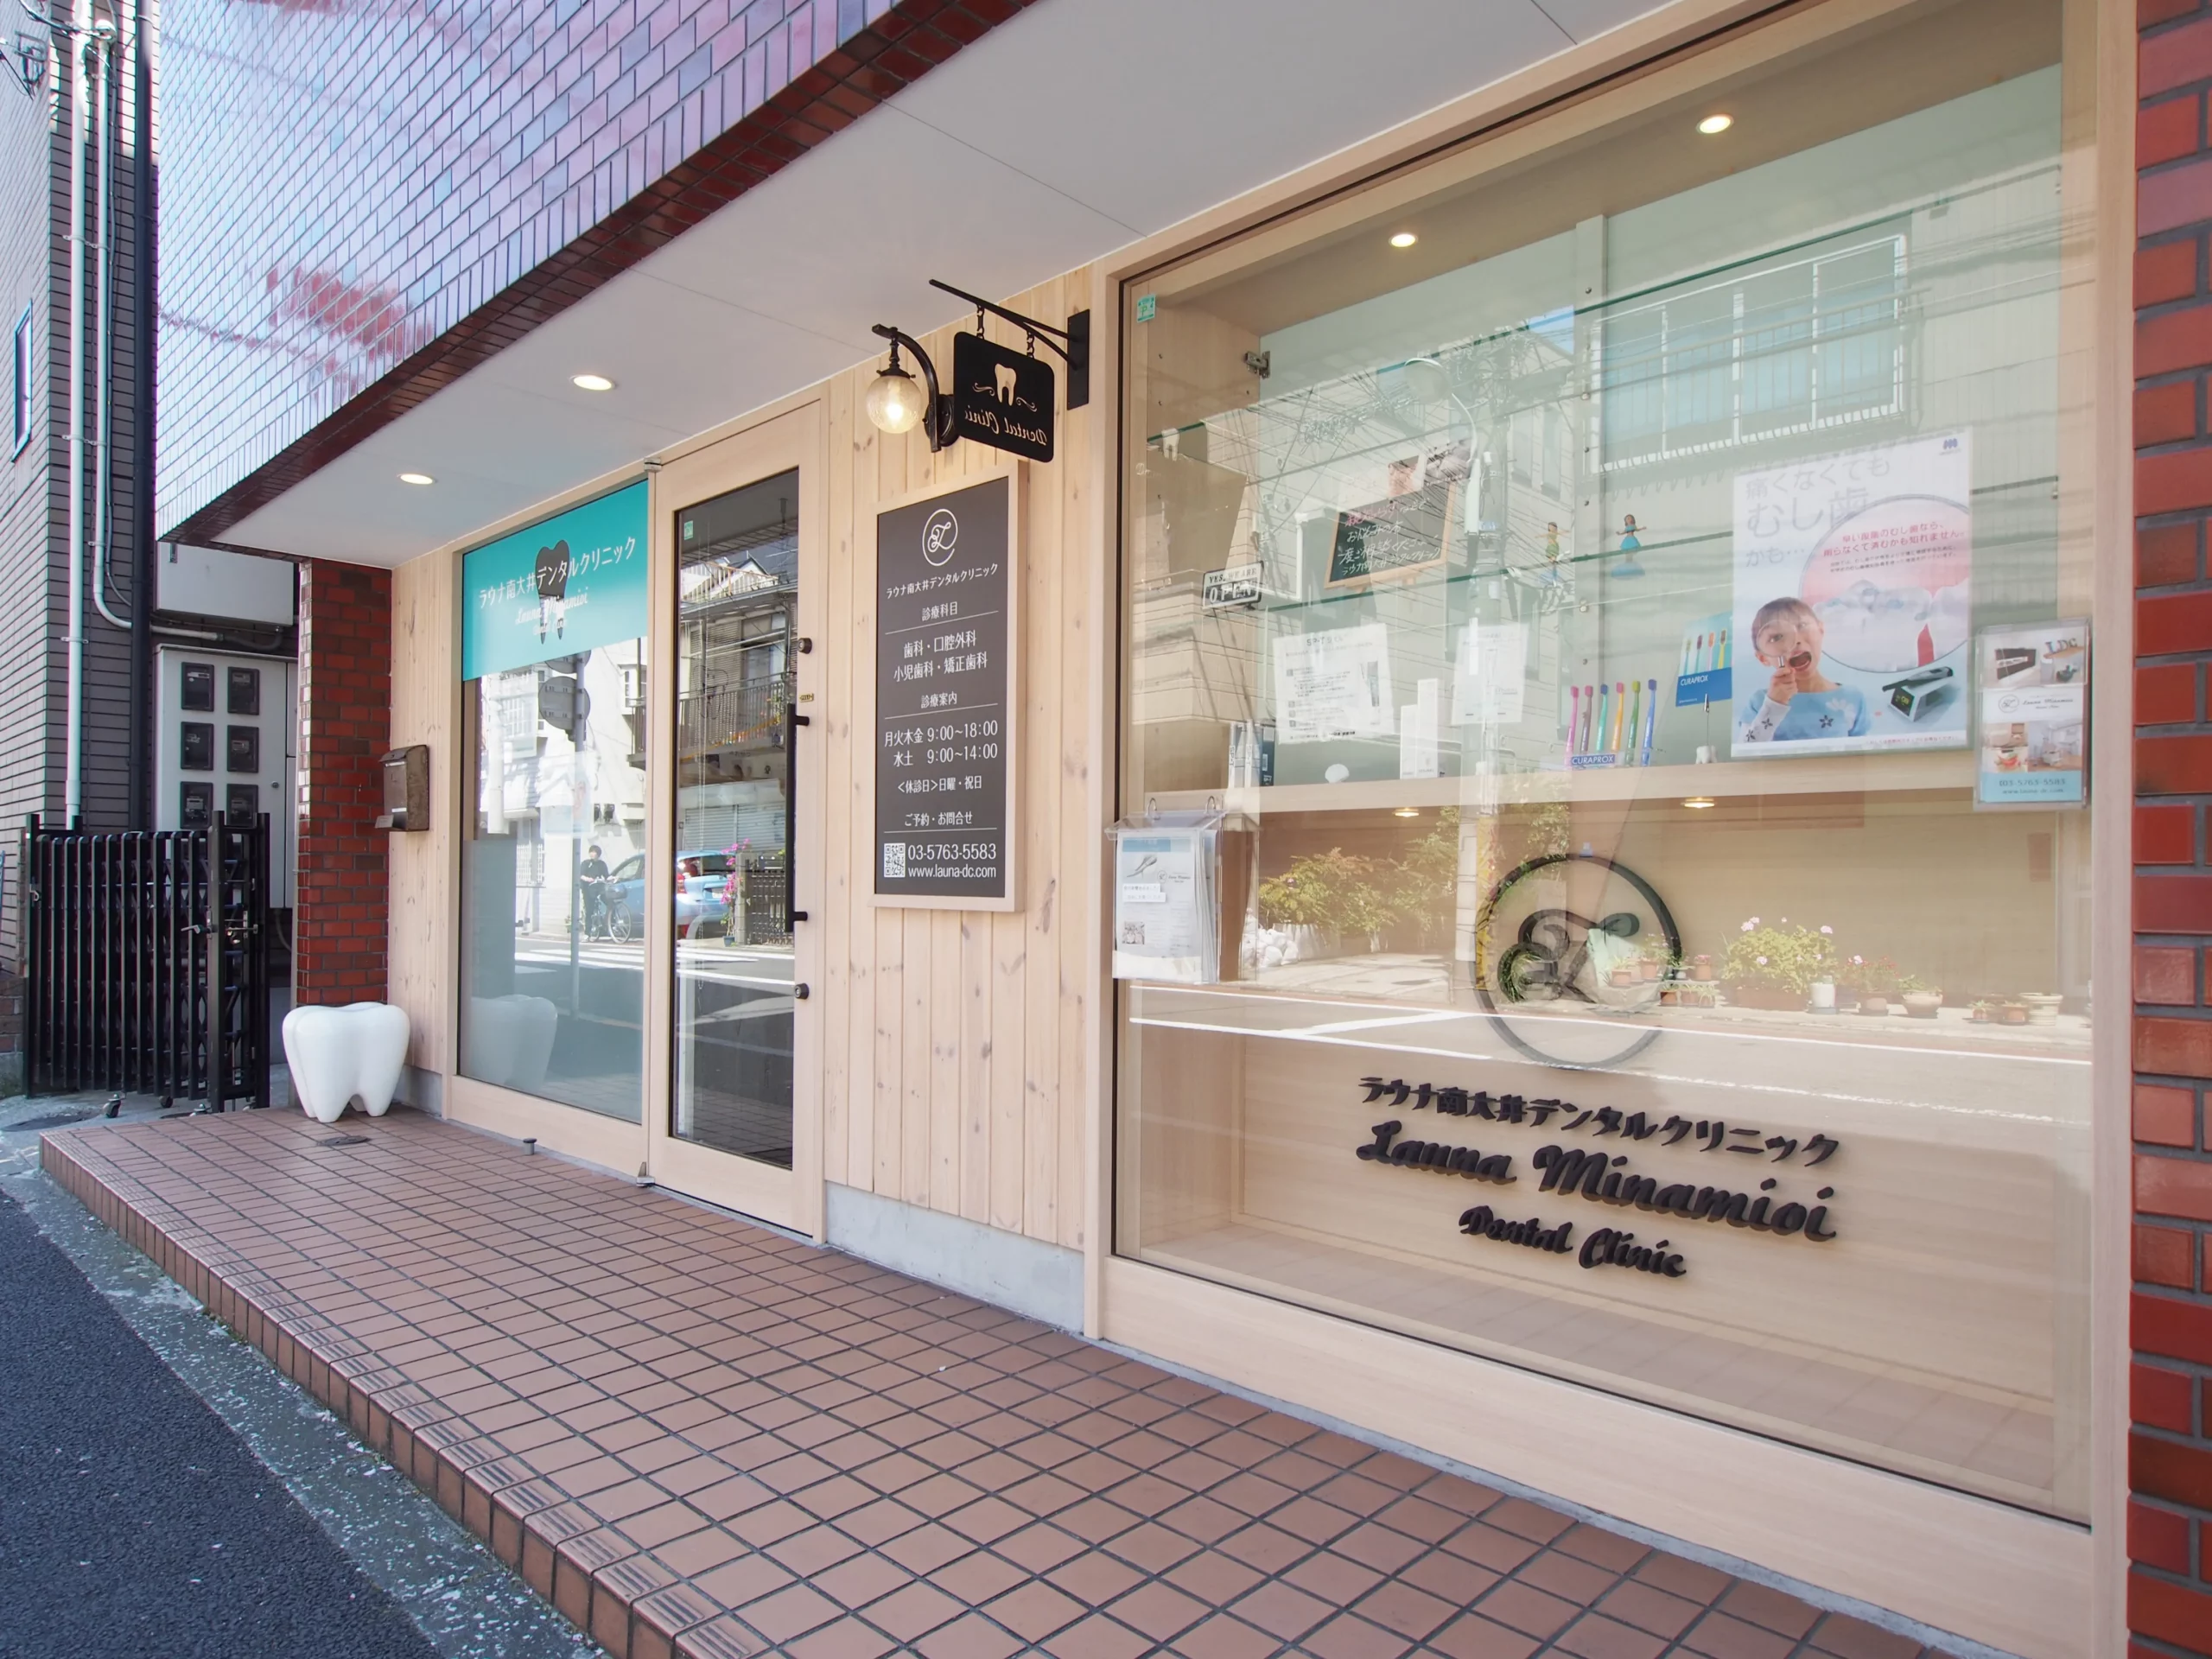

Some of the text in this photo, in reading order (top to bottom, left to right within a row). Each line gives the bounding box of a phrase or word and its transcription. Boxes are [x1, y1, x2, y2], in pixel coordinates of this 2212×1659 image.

[1745, 454, 1891, 500] 痛くなくても
[478, 536, 636, 609] ラウナ南大井デンタルクリニック
[886, 563, 998, 599] ラウナ南大井デンタルクリニック
[921, 601, 958, 621] 診療科目
[904, 629, 976, 658] 歯科・口腔外科
[893, 651, 988, 683] 小児歯科・矯正歯科
[1681, 675, 1708, 686] CURAPROX
[920, 691, 957, 709] 診療案内
[885, 728, 924, 747] 月火木金
[893, 750, 913, 767] 水土
[1572, 755, 1614, 765] CURAPROX
[904, 811, 973, 827] ご予約・お問合せ
[908, 843, 996, 860] 03-5763-5583
[908, 863, 996, 879] www.launa-dc.com
[1358, 1077, 1840, 1167] ラウナ南大井デンタルクリニック
[1356, 1120, 1837, 1243] Launa Minamioi
[1459, 1205, 1687, 1278] Dental Clinic
